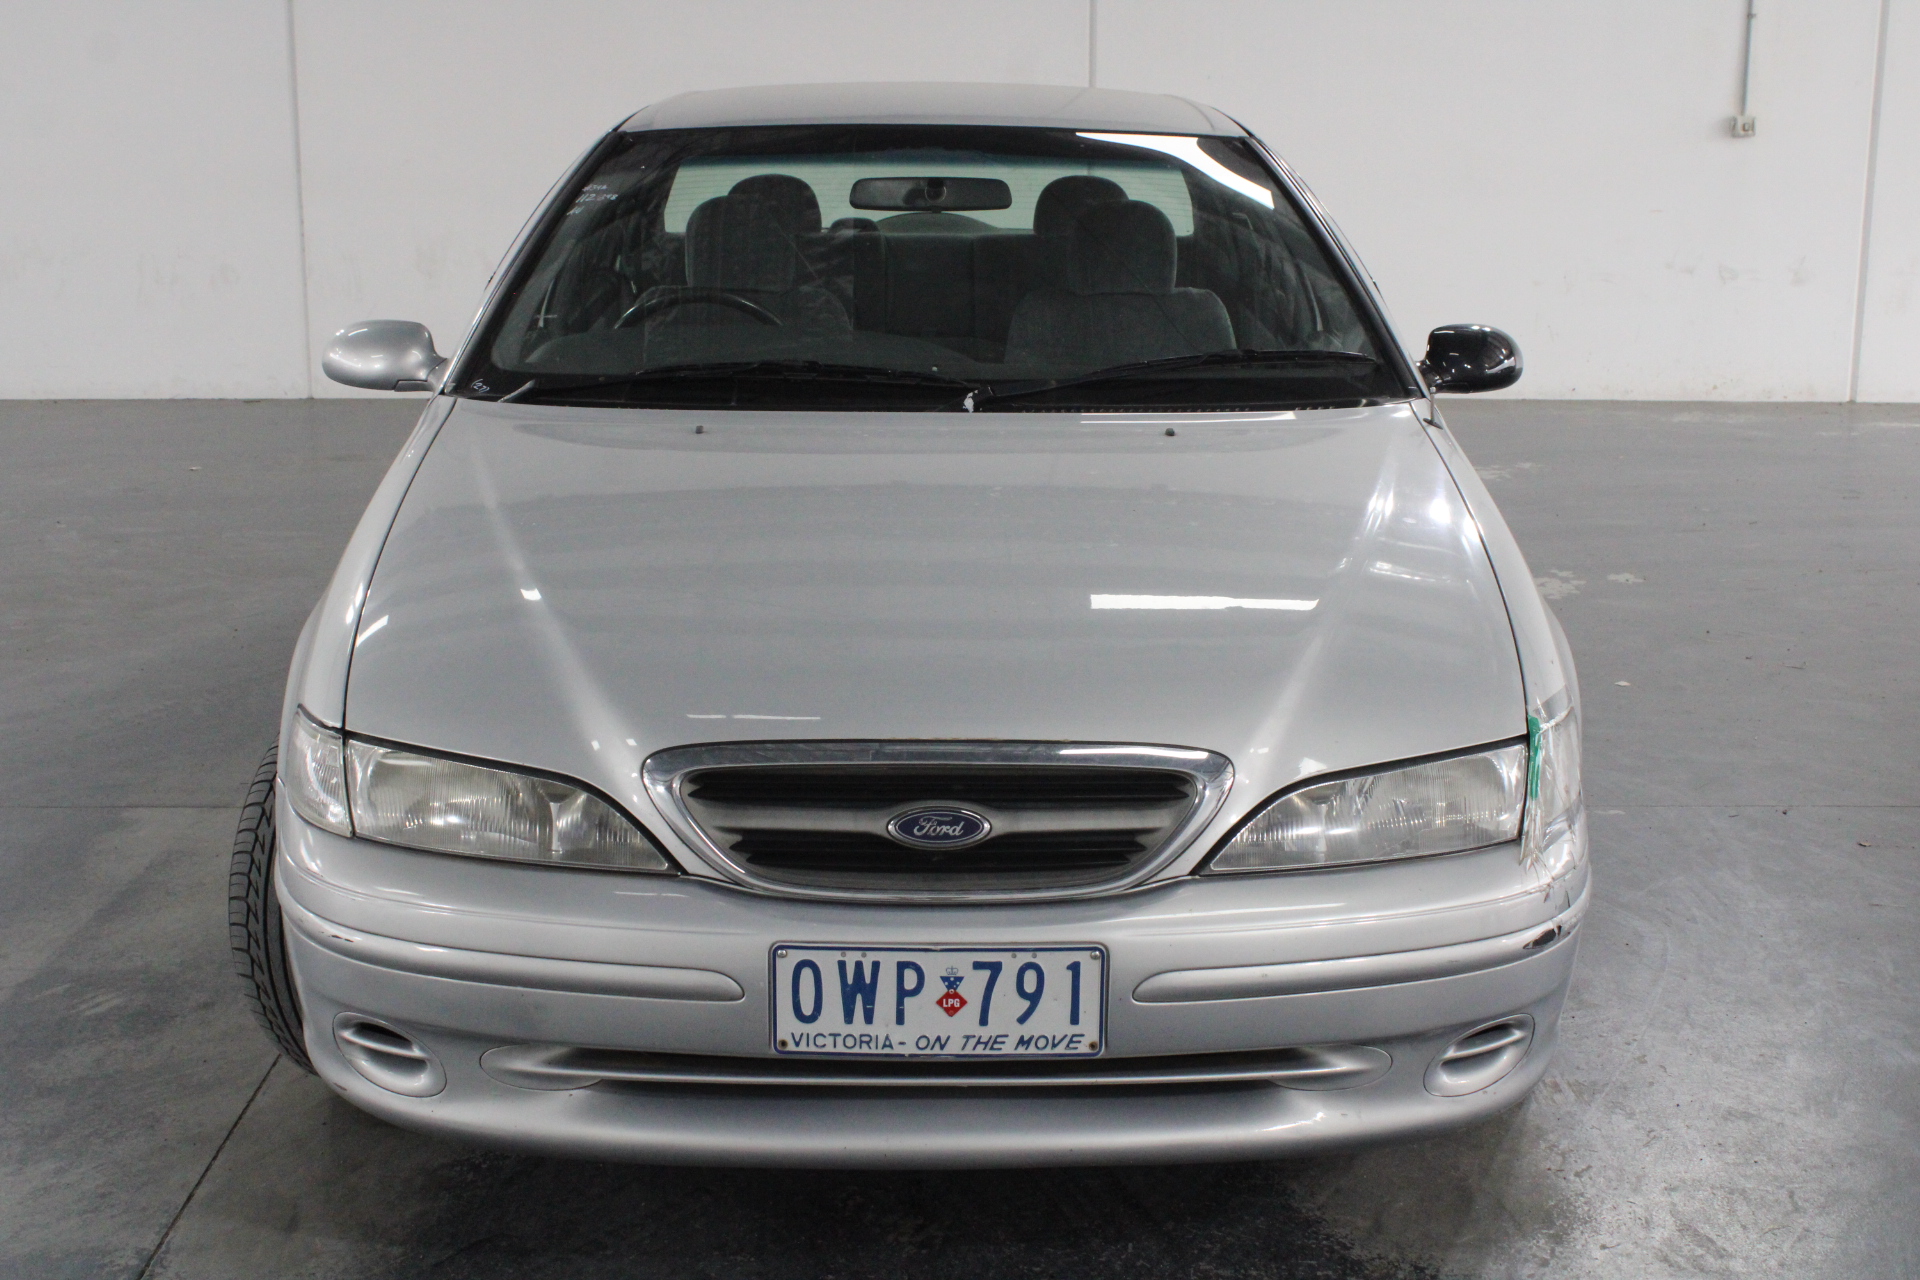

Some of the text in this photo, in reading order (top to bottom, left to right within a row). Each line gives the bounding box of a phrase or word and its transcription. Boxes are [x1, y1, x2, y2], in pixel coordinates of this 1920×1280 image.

[914, 815, 965, 836] Ford
[791, 958, 1082, 1027] OWP 791
[942, 998, 961, 1008] LPG
[915, 1034, 951, 1051] ON
[960, 1034, 1010, 1051] THE
[1013, 1033, 1086, 1051] MOVE
